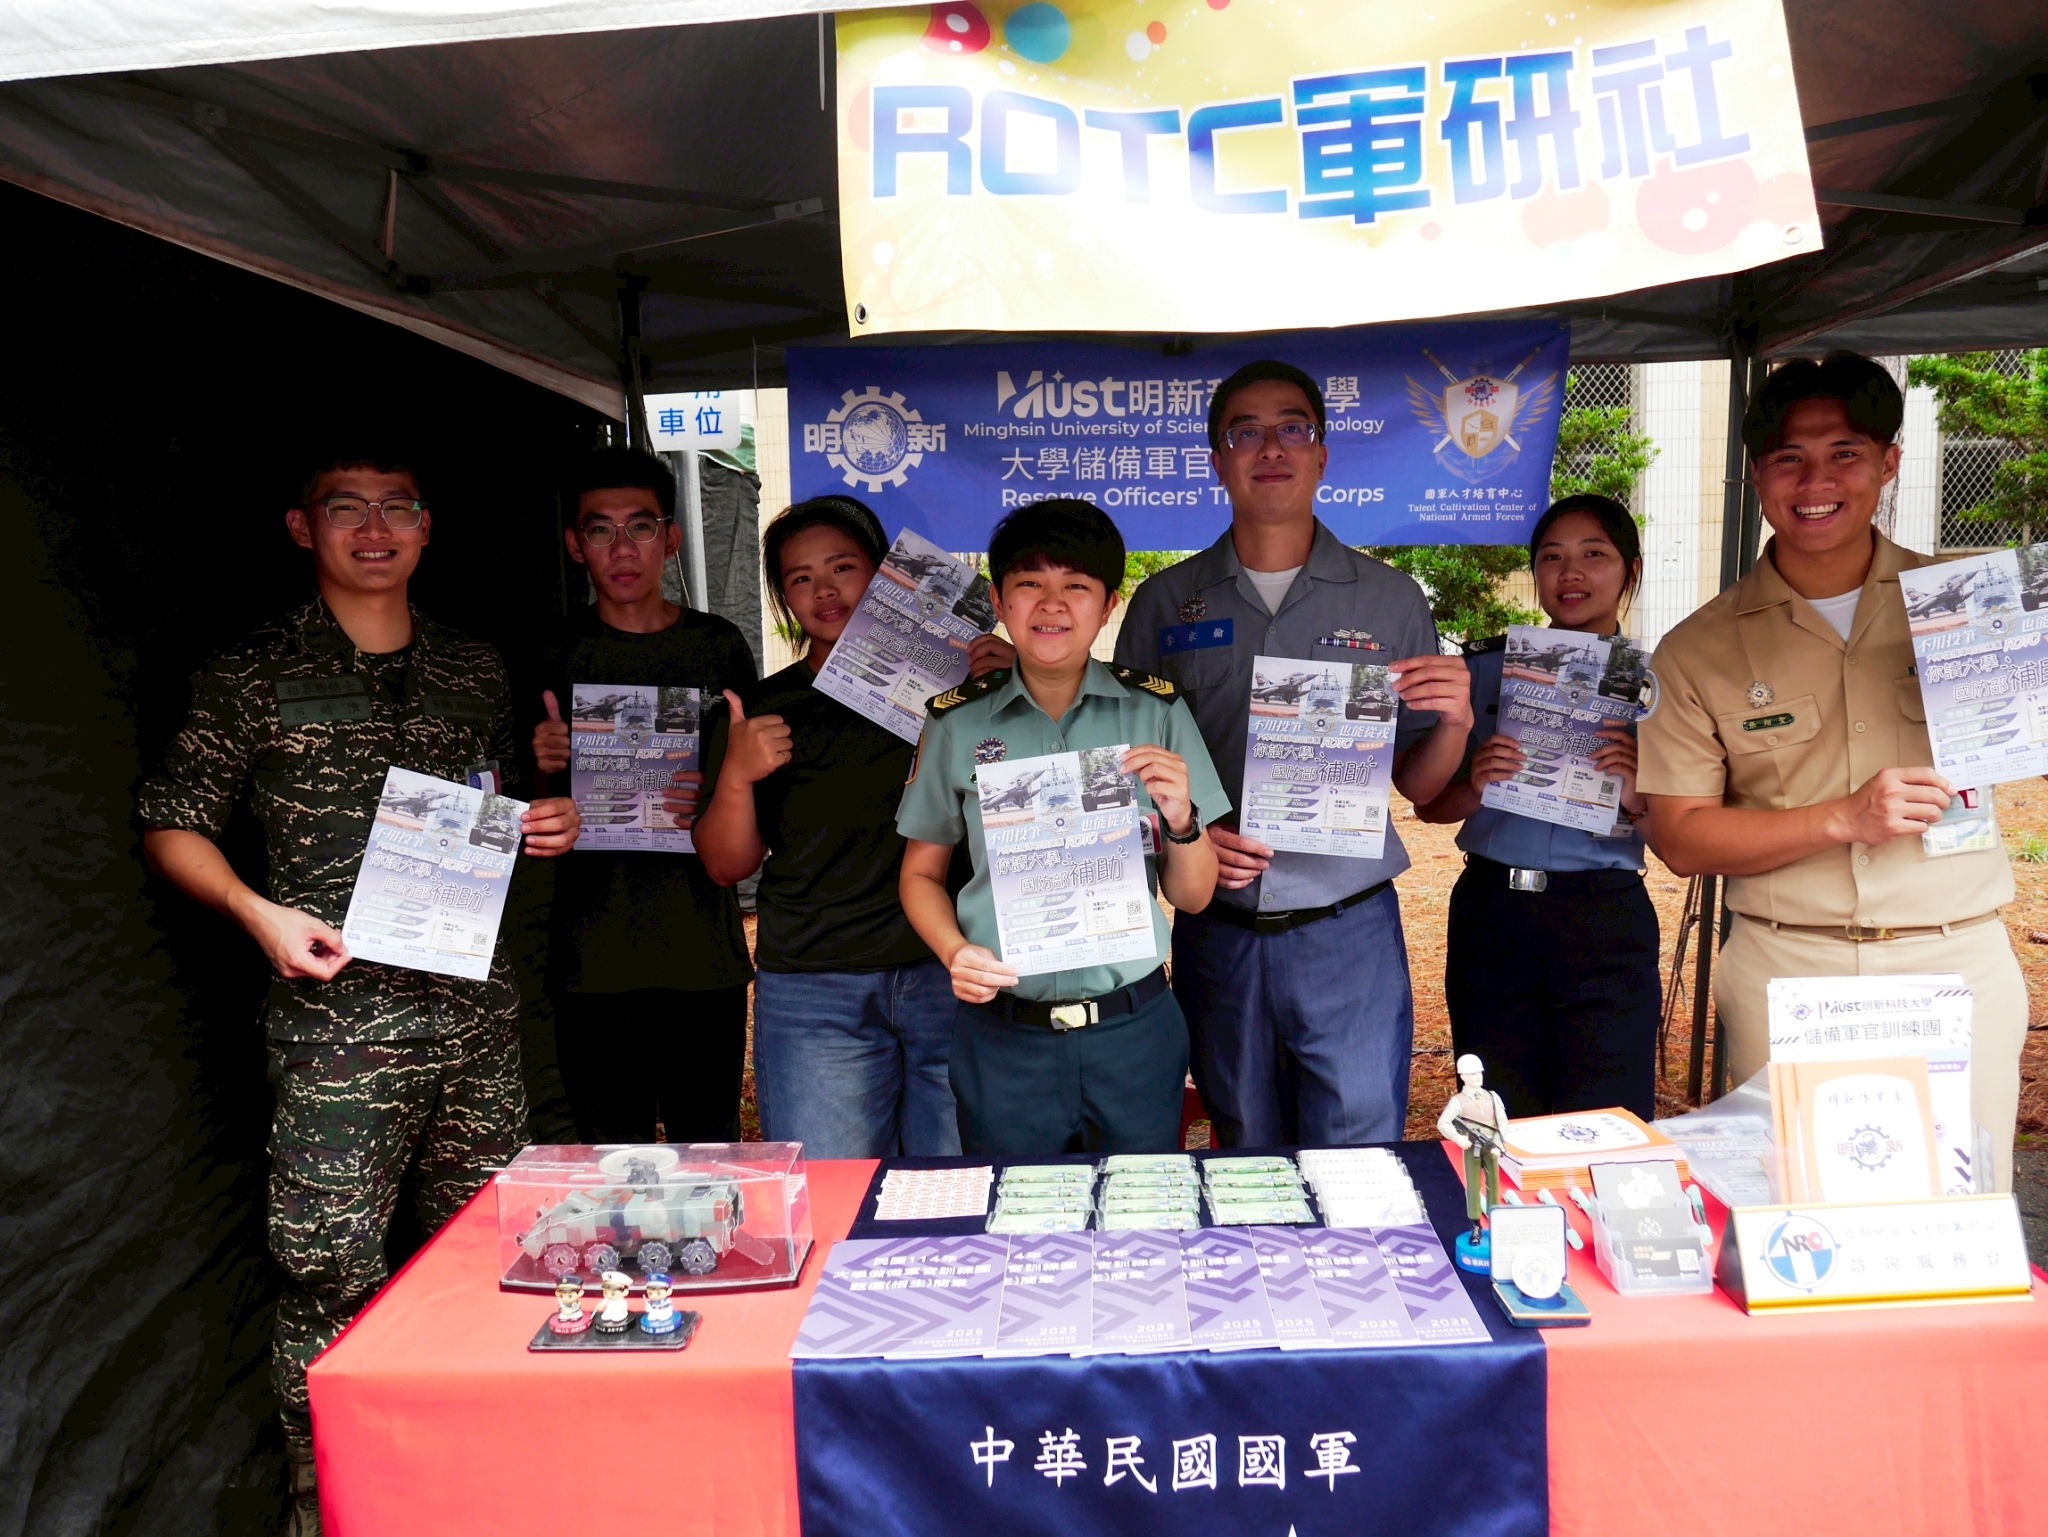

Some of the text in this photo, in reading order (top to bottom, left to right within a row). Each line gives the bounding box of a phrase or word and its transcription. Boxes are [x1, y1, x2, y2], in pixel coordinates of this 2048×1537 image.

[997, 371, 1125, 419] Must
[657, 405, 724, 436] 車位
[964, 416, 1385, 440] Minghsin University of Scien nology
[1001, 445, 1212, 481] 大學儲備軍官
[1104, 486, 1203, 507] Officers'
[1316, 485, 1385, 507] Corps
[1425, 488, 1523, 500] 國軍人才培育中心
[1408, 503, 1537, 512] Talent Cultivation Center of
[1419, 513, 1525, 521] National Armed Forces
[860, 596, 915, 638] 你讀大學
[1915, 627, 1977, 653] 不用投筆
[2001, 631, 2042, 652] ROTC
[1924, 653, 2001, 684] 你讀大學
[1251, 716, 1389, 739] 不用投筆 也能從戎
[1252, 742, 1315, 762] 你讀大學
[1320, 735, 1354, 750] ROTC
[372, 823, 426, 849] 不用投筆
[986, 811, 1133, 845] 不用投筆 也能從戎
[1063, 831, 1099, 849] ROTC
[368, 848, 433, 881] 你讀大學
[438, 855, 473, 875] ROTC
[994, 849, 1062, 875] 你讀大學
[1824, 997, 1933, 1015] Must 明新科技大學
[1804, 1019, 1942, 1045] 儲備軍官訓練團
[872, 1254, 958, 1266] 民國114年
[832, 1264, 992, 1279] 大學儲備軍官訓練團
[945, 1327, 984, 1338] 2025
[1039, 1325, 1078, 1336] 2025
[1136, 1322, 1175, 1333] 2025
[1222, 1318, 1262, 1329] 2025
[1275, 1318, 1314, 1328] 2025
[1359, 1318, 1399, 1329] 2025
[1430, 1317, 1470, 1328] 2025
[969, 1426, 1361, 1493] 中華民國國軍
